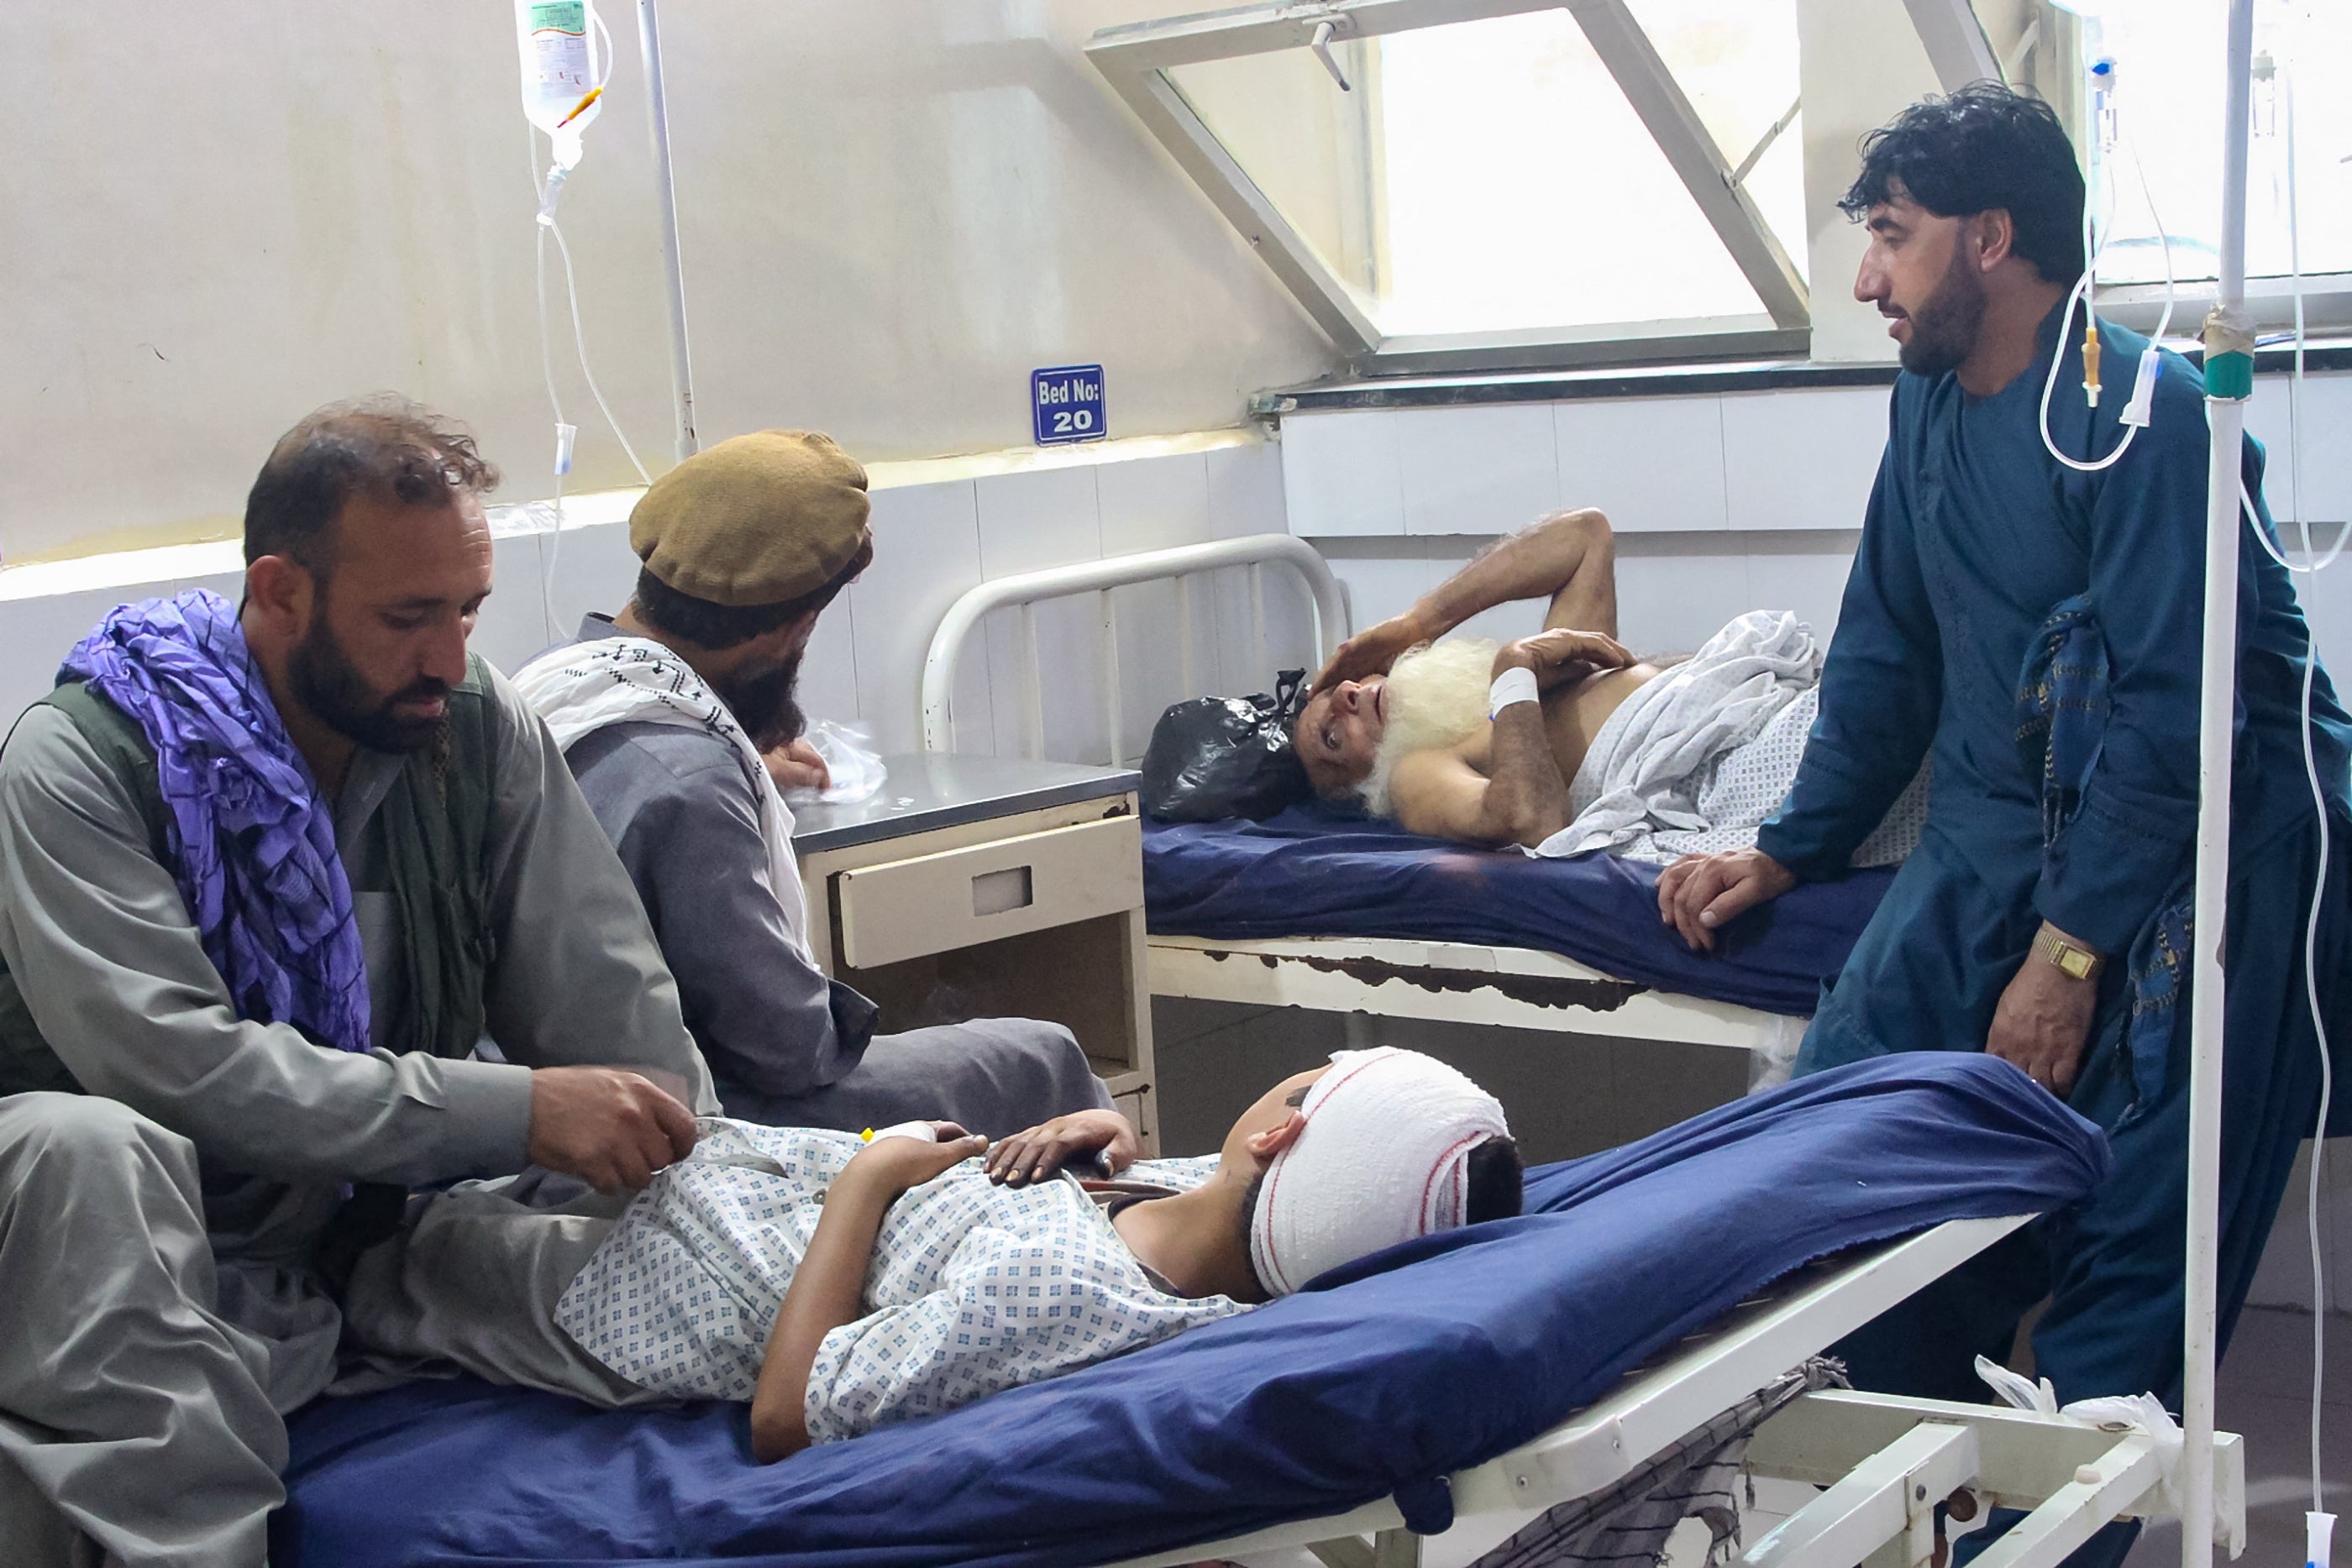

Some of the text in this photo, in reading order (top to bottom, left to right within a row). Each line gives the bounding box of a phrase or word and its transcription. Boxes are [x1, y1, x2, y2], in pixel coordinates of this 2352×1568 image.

[1038, 379, 1099, 405] Bed No:
[1053, 410, 1093, 433] 20
